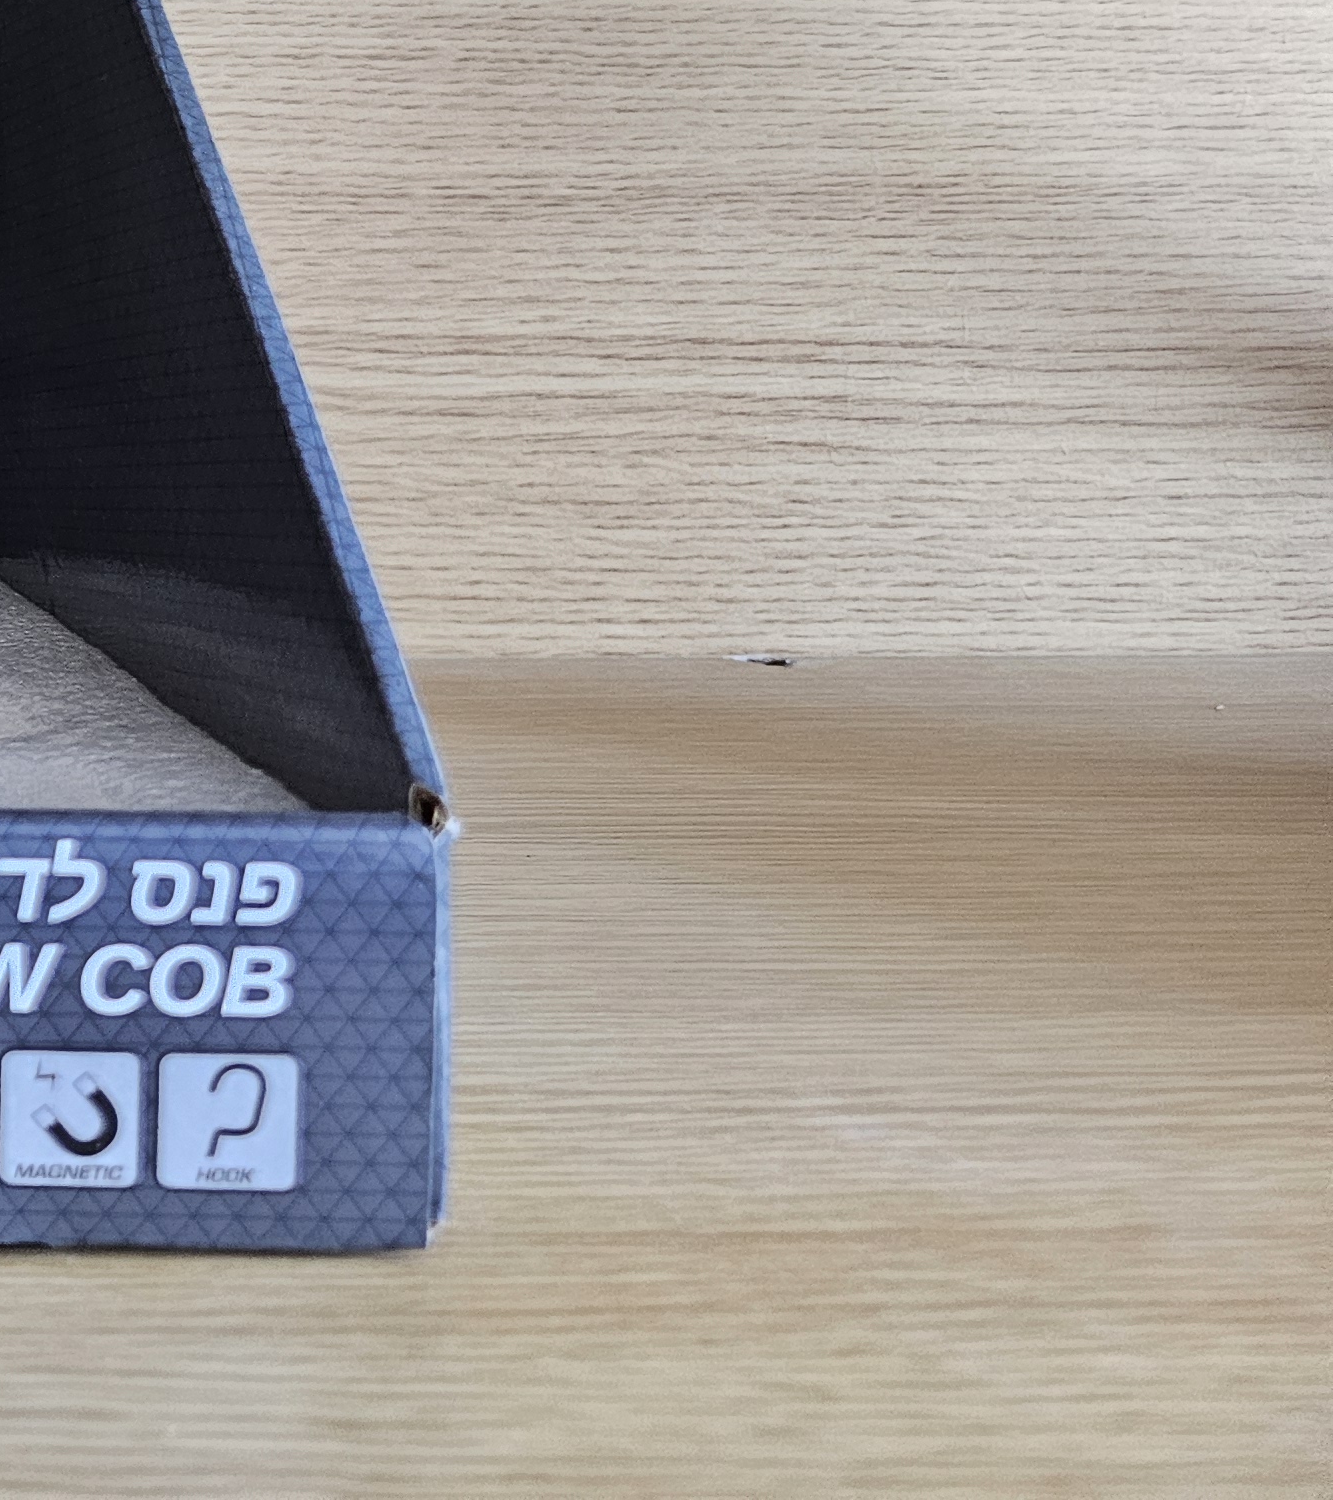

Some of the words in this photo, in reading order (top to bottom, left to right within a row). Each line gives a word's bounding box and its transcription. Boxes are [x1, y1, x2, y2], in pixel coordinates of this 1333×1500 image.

[130, 859, 302, 925] פנס
[79, 942, 294, 1017] COB
[14, 1162, 125, 1181] MAGNETIC
[195, 1166, 255, 1183] HOOK
